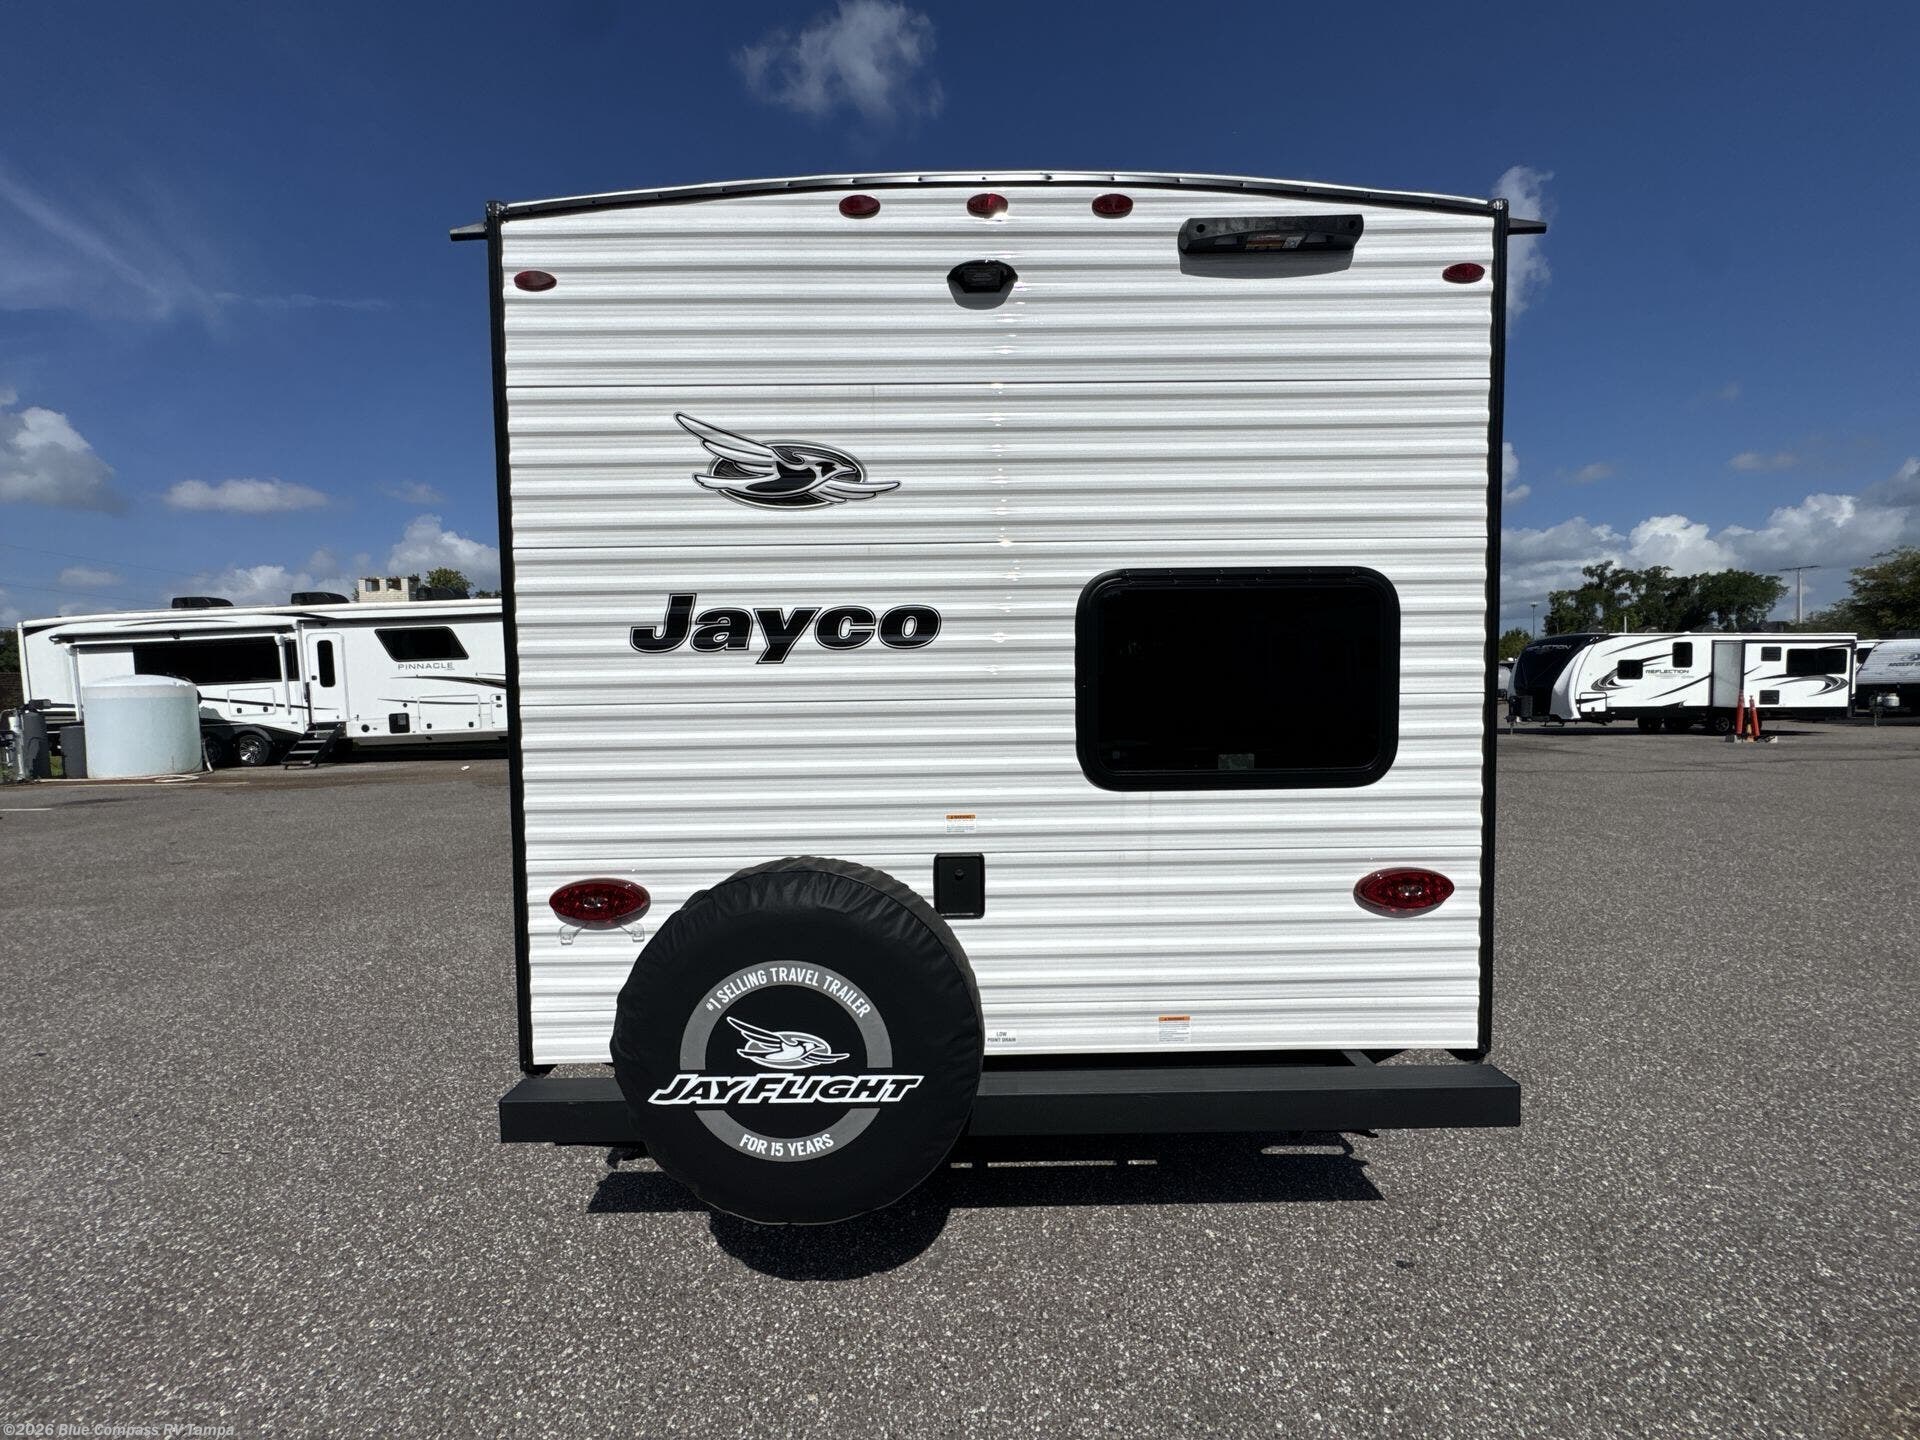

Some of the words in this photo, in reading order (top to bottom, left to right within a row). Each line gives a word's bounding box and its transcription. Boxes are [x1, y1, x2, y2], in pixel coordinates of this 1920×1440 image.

[629, 593, 942, 664] Jayco
[397, 662, 453, 670] PINNACLE
[705, 998, 722, 1012] #1
[717, 970, 768, 1004] SELLING
[769, 967, 819, 987] TRAVEL
[823, 975, 872, 1019] TRAILER
[739, 1133, 768, 1155] FOR
[770, 1142, 784, 1157] 15
[787, 1133, 835, 1157] YEARS
